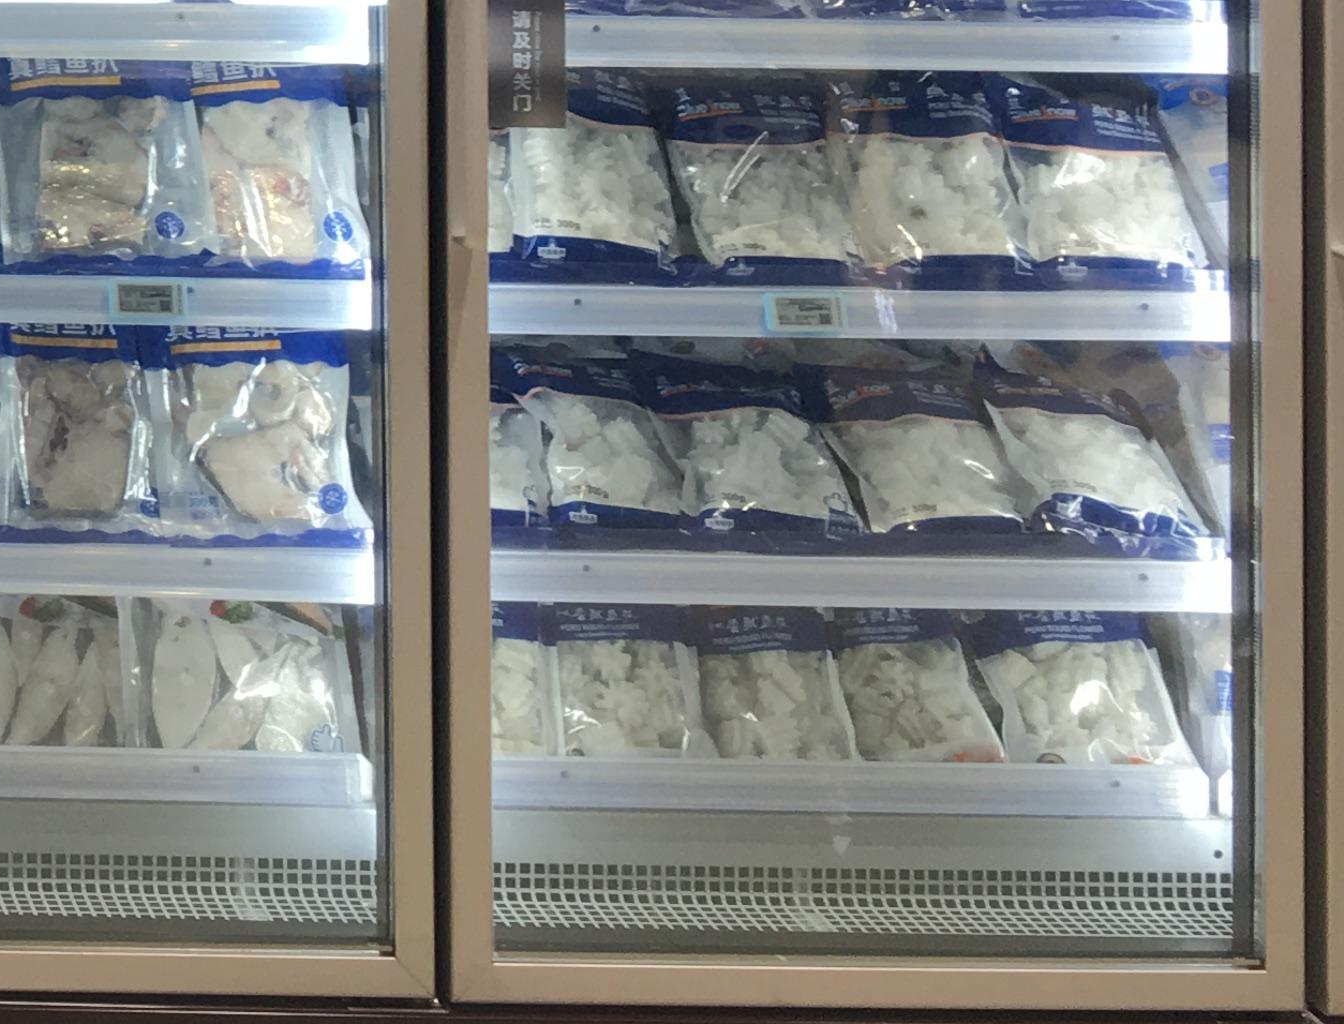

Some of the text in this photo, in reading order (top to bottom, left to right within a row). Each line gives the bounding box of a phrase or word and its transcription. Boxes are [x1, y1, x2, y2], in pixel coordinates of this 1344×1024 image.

[512, 10, 531, 113] 请及时关门
